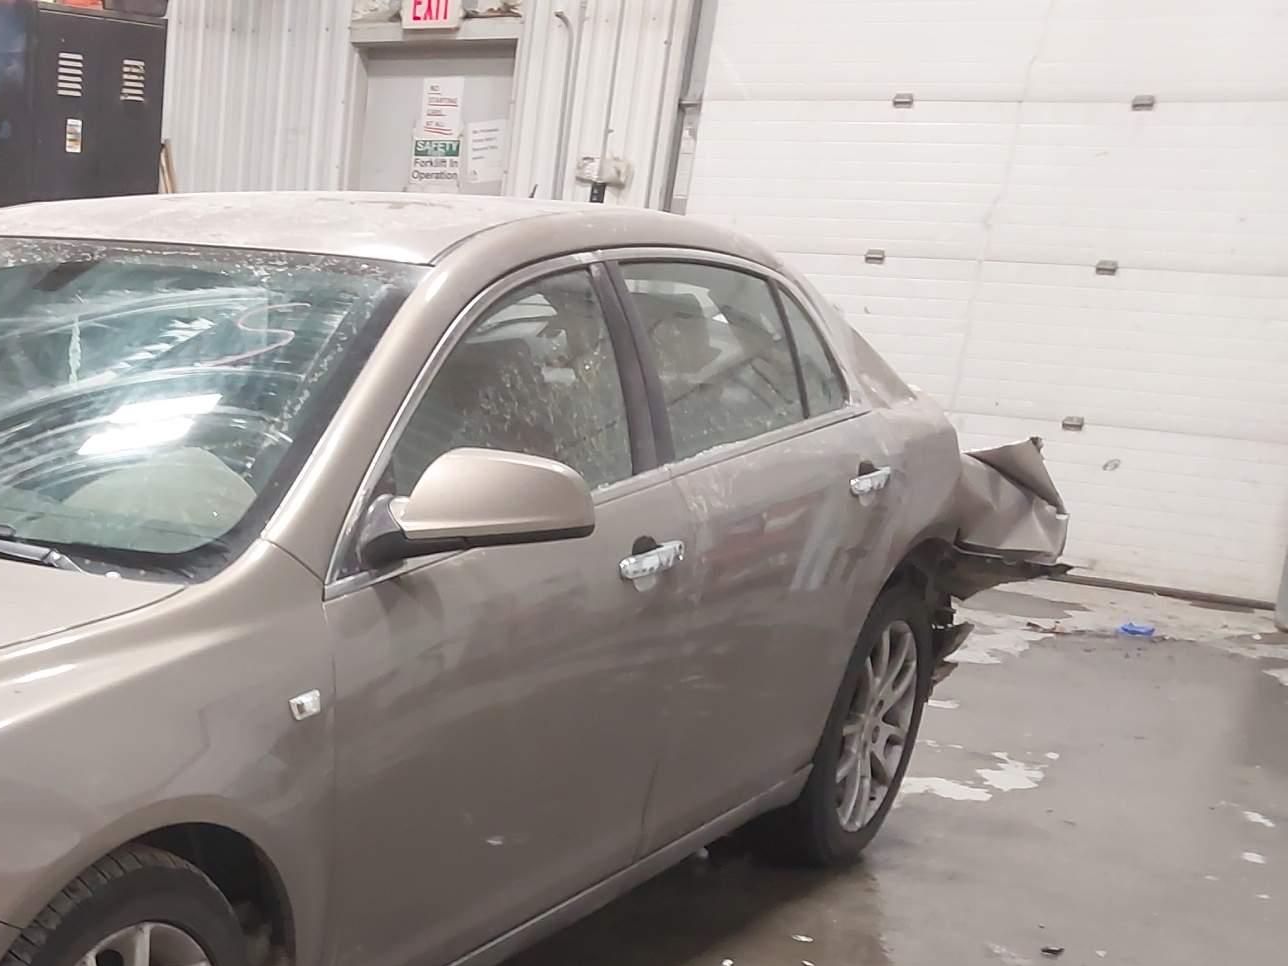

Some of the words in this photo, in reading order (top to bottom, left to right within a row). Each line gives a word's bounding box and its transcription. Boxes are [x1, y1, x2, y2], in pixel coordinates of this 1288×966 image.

[416, 141, 458, 151] SAFETY
[414, 158, 447, 168] Forklift
[449, 158, 458, 168] In
[411, 170, 458, 181] Operation
